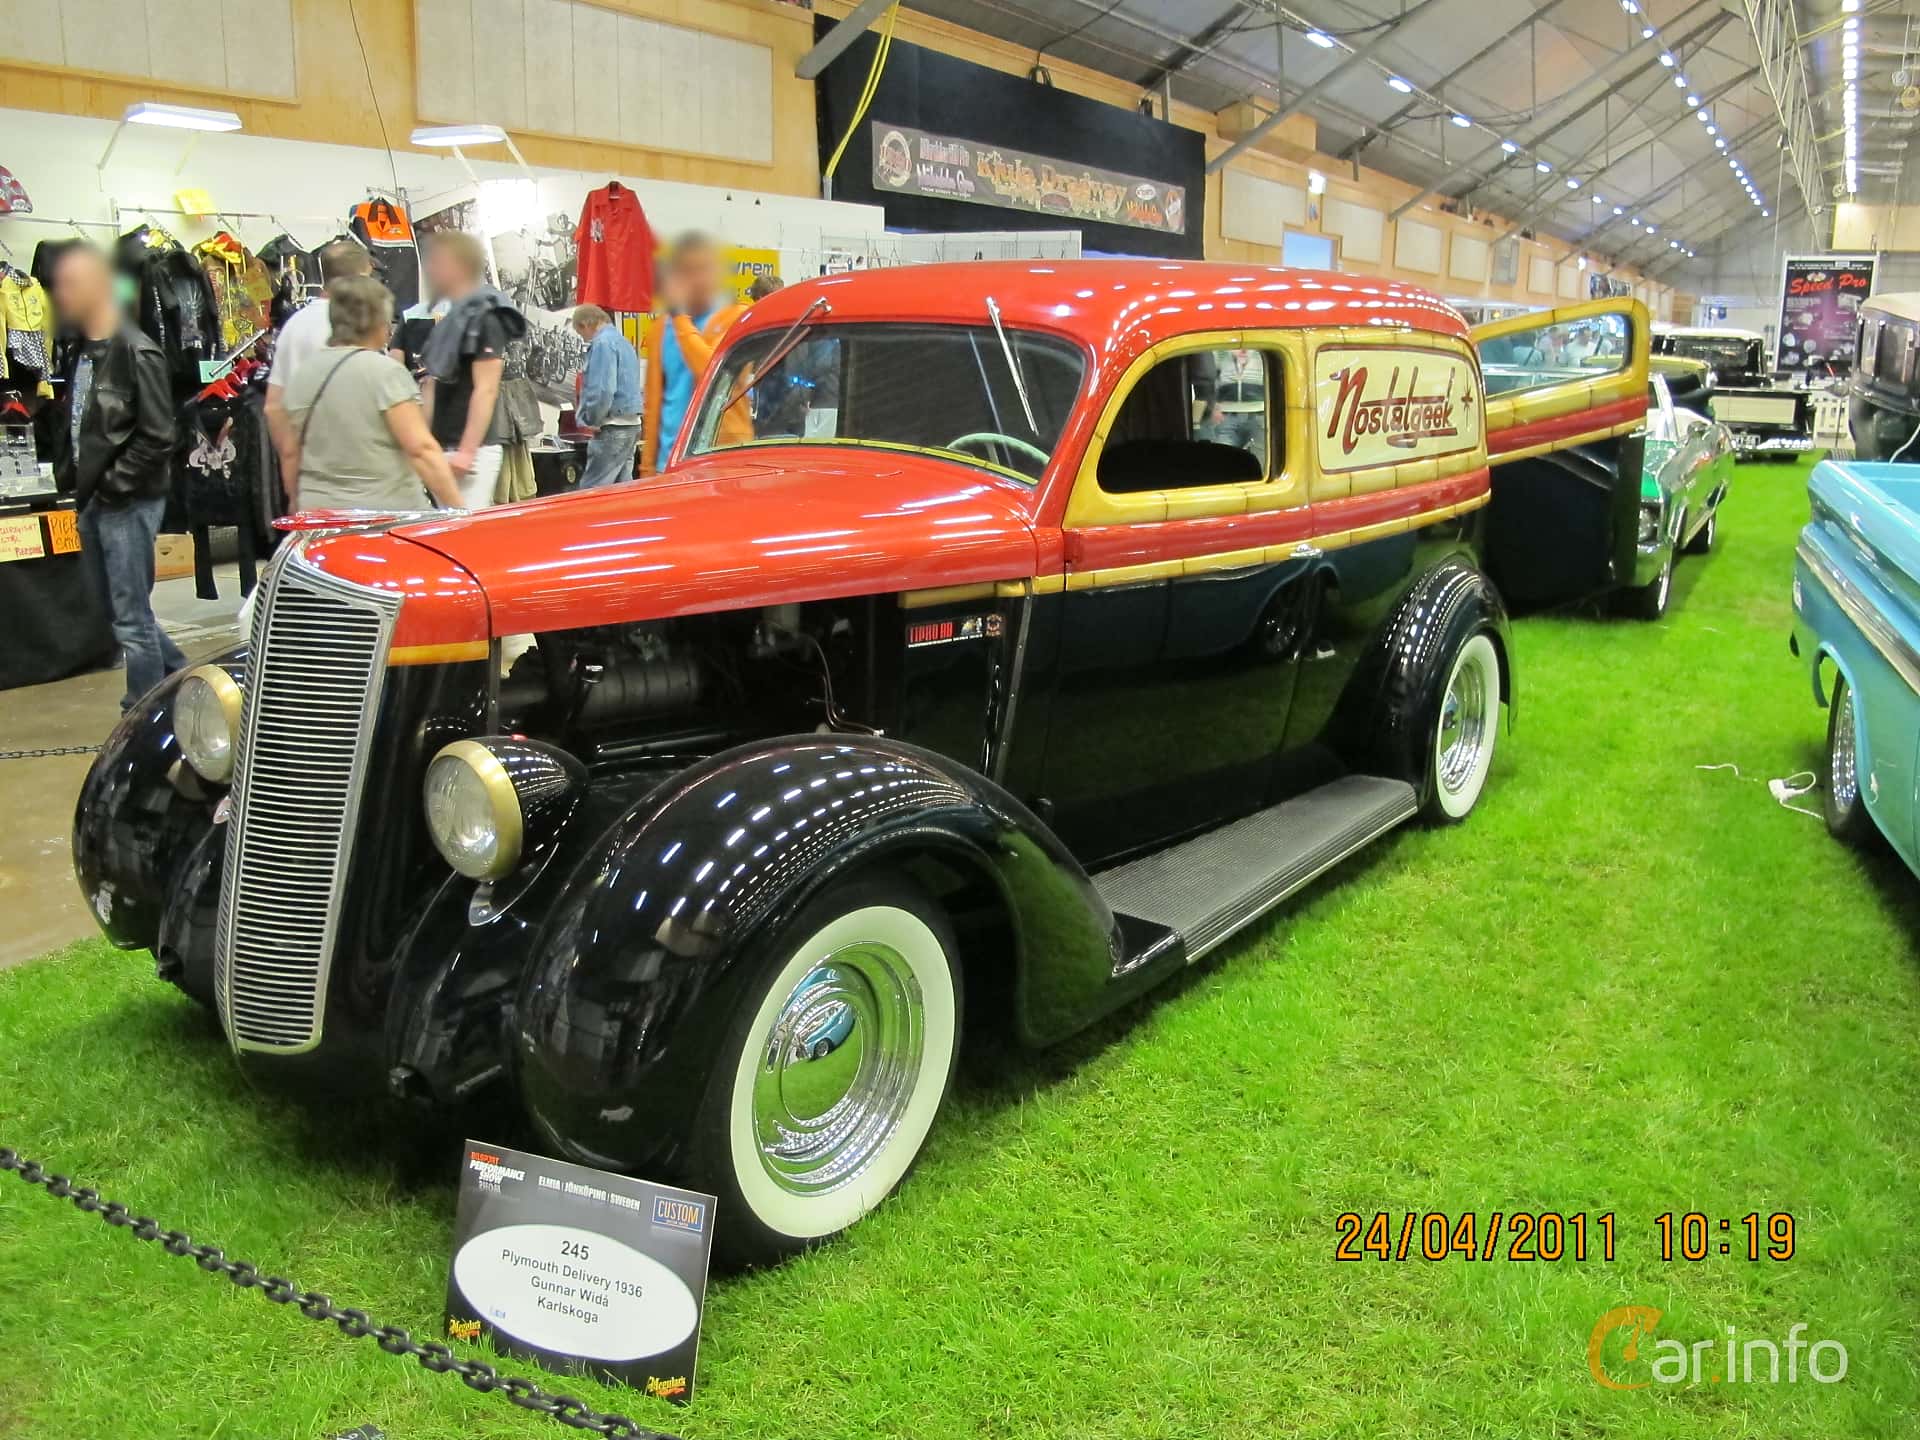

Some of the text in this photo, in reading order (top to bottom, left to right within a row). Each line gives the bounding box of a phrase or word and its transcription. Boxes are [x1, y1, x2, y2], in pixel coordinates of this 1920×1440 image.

[1789, 274, 1867, 296] Speed Pro
[469, 1160, 526, 1181] PERFORMANCE
[564, 1181, 606, 1201] JÖNKÖPING
[610, 1192, 641, 1211] SWEDEN
[658, 1200, 699, 1225] CUSTOM
[561, 1240, 590, 1261] 245
[501, 1249, 643, 1298] Plymouth Delivery 1936
[530, 1275, 577, 1297] Gunnar
[537, 1296, 599, 1323] Karlskoga
